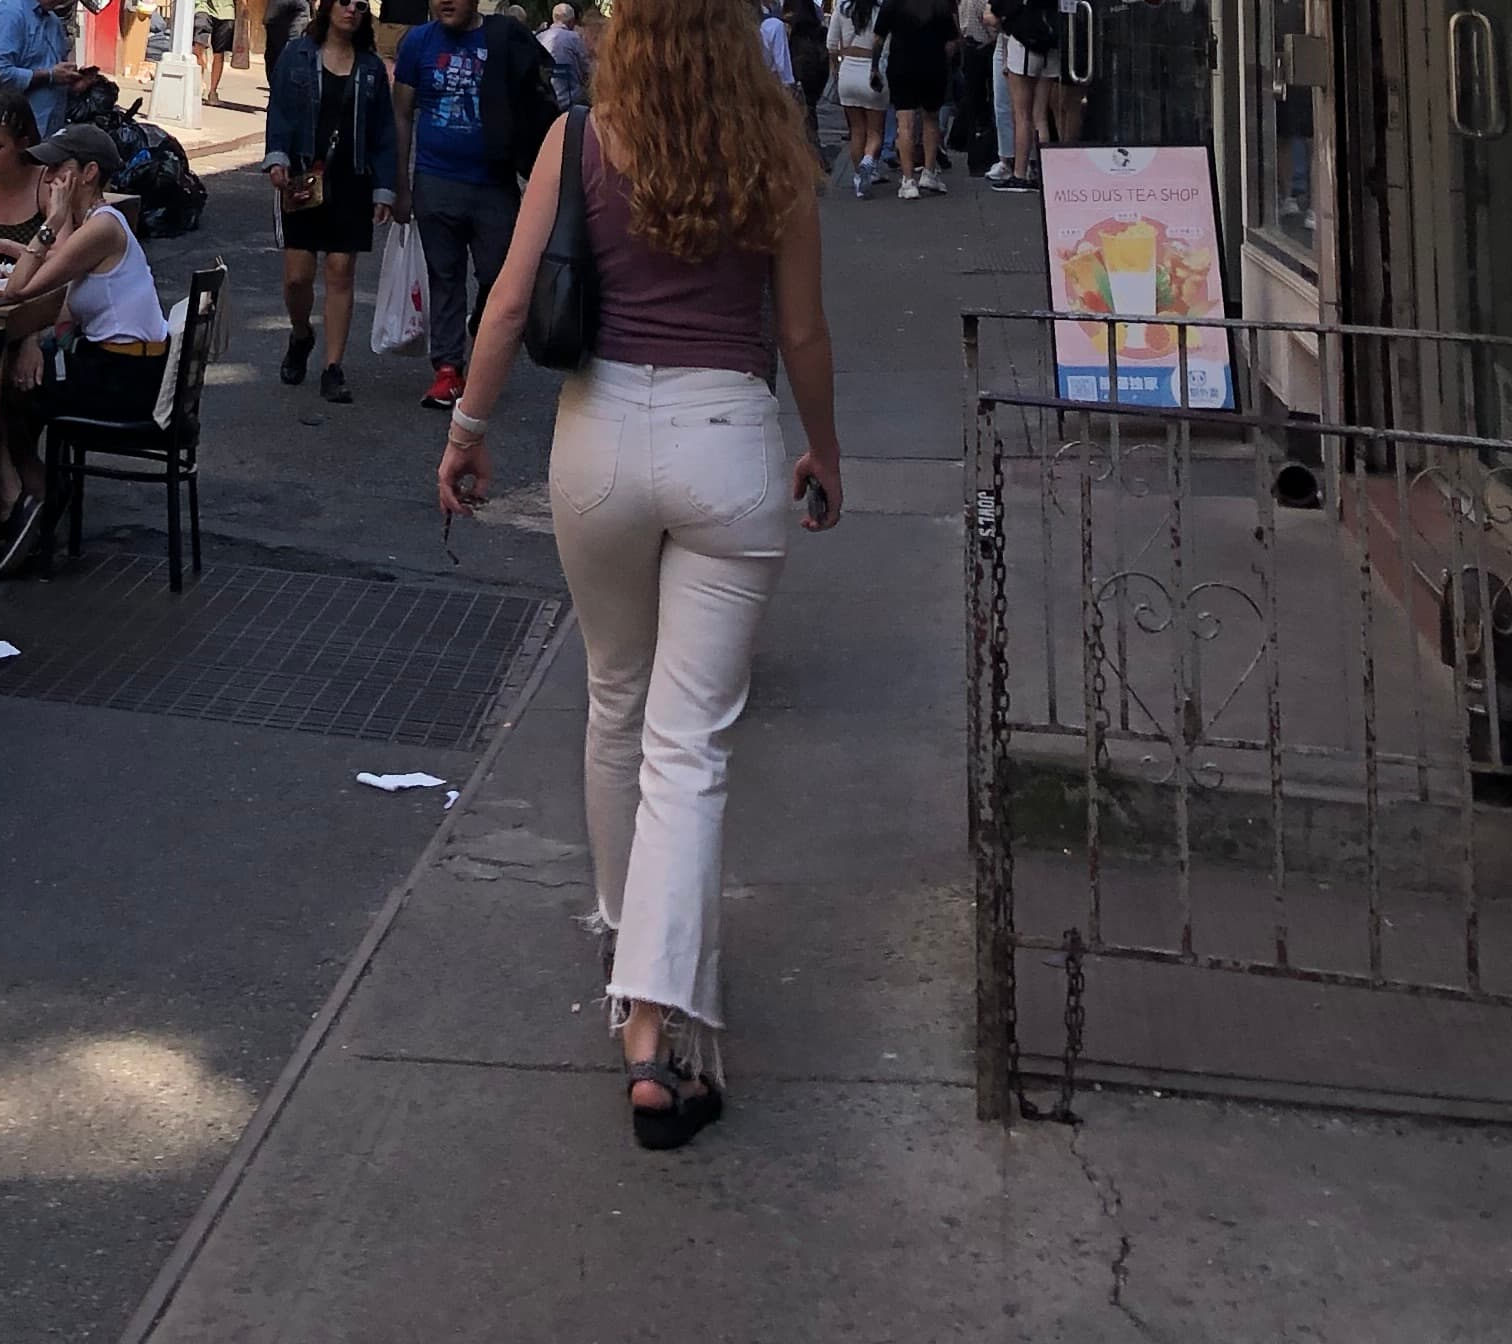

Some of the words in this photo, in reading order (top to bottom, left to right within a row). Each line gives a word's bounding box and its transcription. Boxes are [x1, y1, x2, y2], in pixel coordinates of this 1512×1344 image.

[1054, 188, 1088, 202] MISS
[1127, 188, 1157, 202] TEA
[1160, 187, 1199, 202] SHOP
